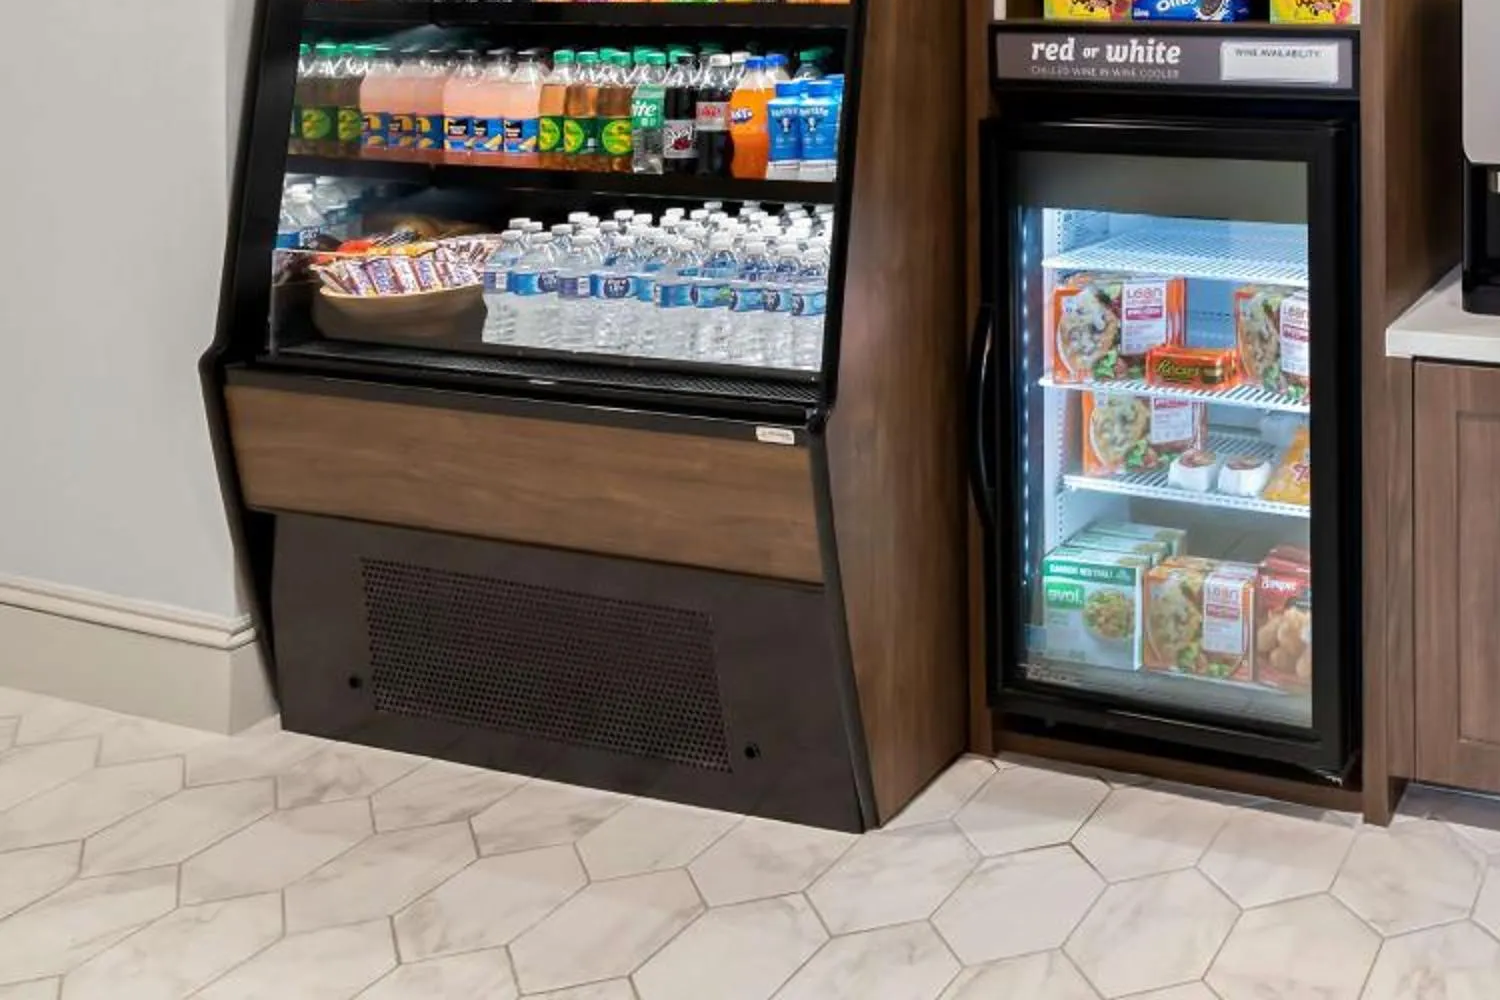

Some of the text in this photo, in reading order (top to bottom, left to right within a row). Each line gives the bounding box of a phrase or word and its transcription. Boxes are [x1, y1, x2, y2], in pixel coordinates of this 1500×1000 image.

[1031, 36, 1181, 64] red or white
